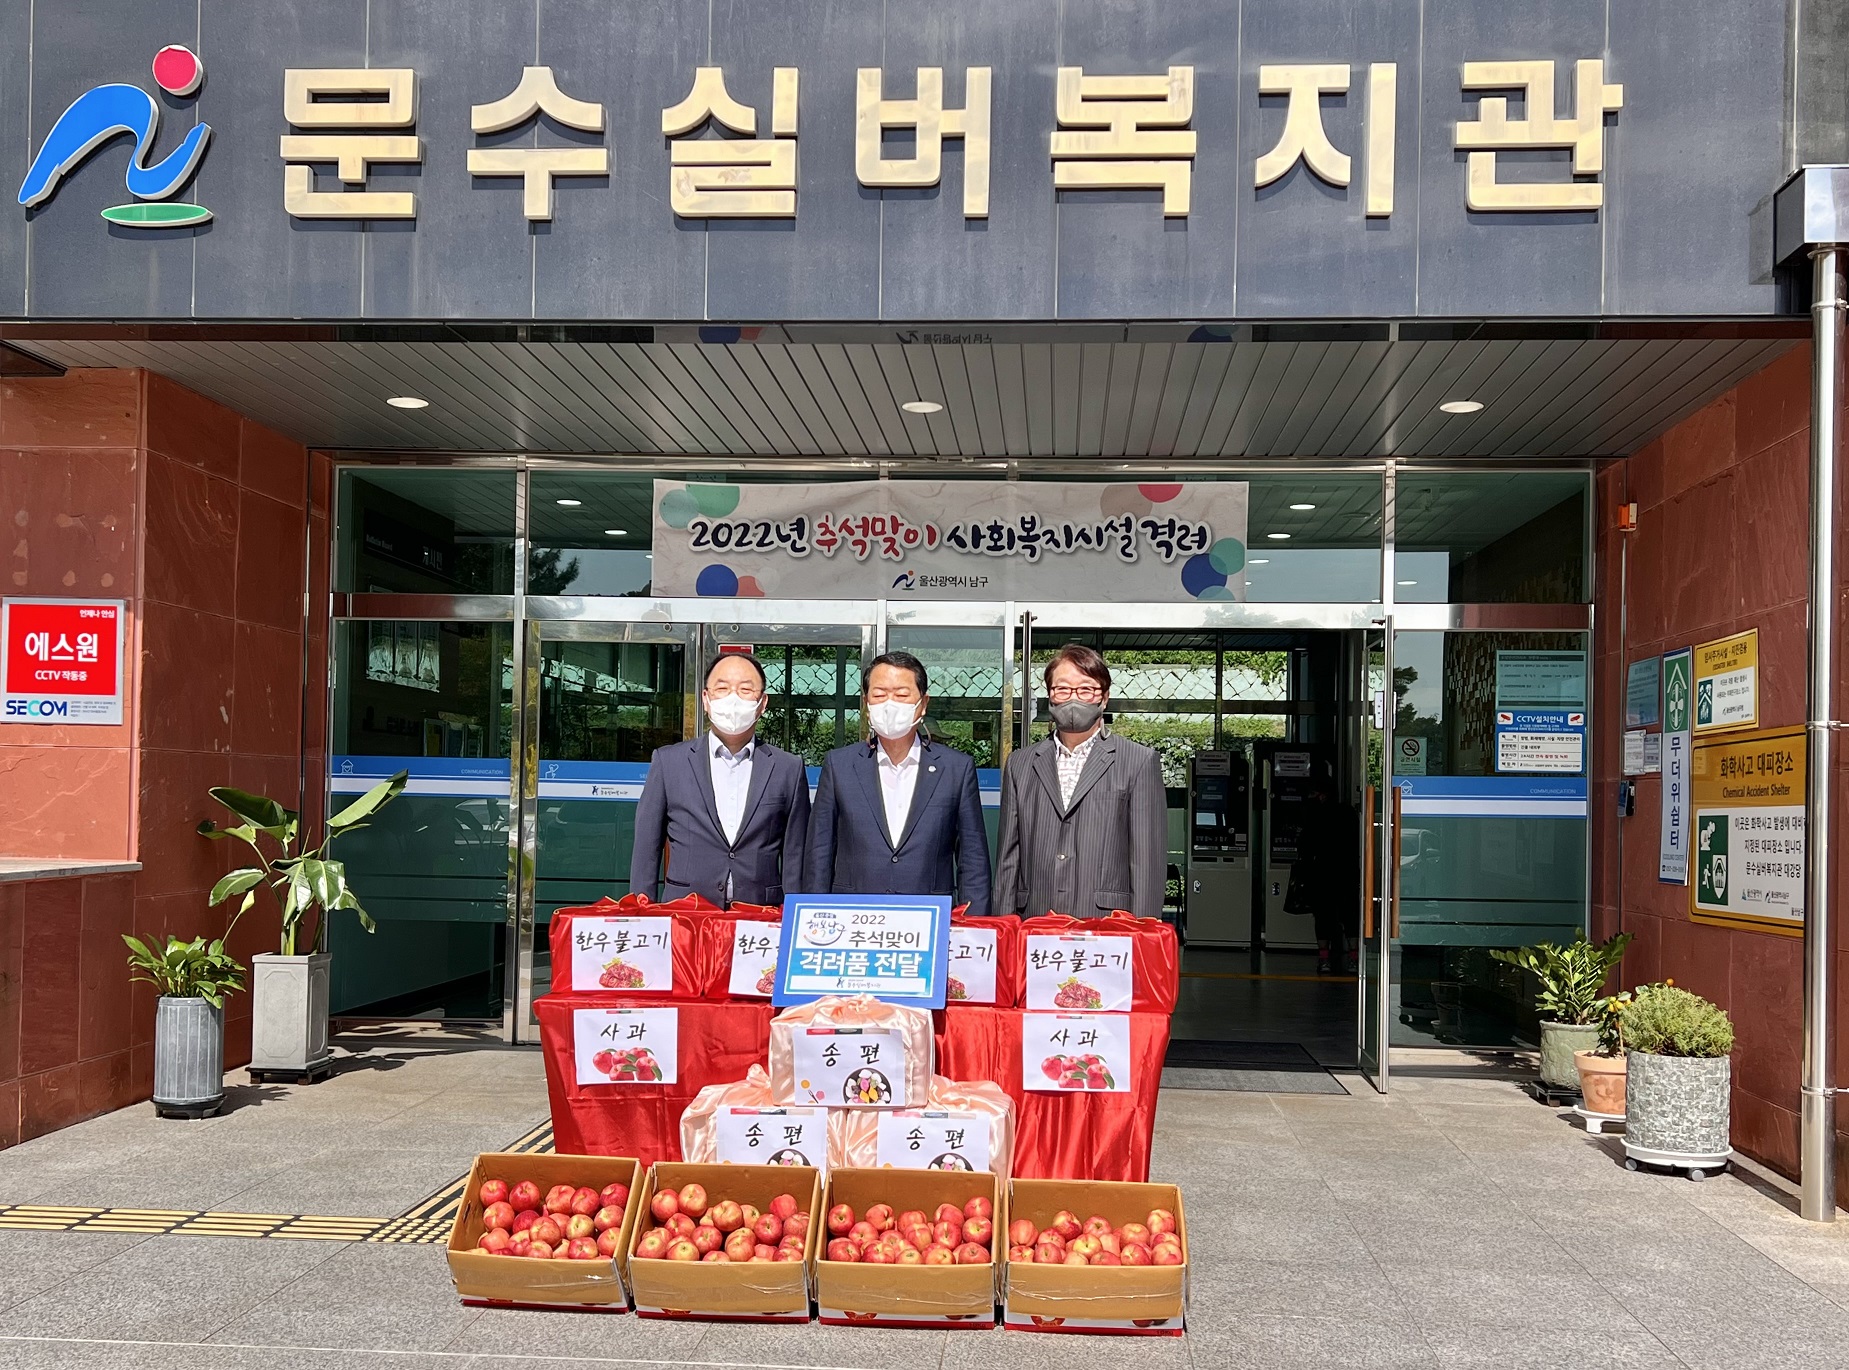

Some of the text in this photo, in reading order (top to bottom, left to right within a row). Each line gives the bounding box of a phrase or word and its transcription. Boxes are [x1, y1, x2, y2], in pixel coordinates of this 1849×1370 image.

[280, 58, 1624, 220] 문수실버복지관
[690, 514, 1208, 559] 2022년 추석맞이 사회복지시설 격려
[918, 575, 989, 588] 울산광역시 남구
[24, 632, 98, 662] 에스원
[35, 670, 87, 681] CCTV 작동중
[6, 699, 68, 717] SECOM
[1516, 715, 1564, 723] CCTV설치안내
[1720, 750, 1794, 779] 화학사고 대피장소
[1670, 736, 1682, 850] 무더위쉼터
[1722, 783, 1791, 798] Chemical Accident Shelter
[1735, 817, 1750, 831] 이곳은
[1751, 816, 1772, 831] 화학사고
[1773, 816, 1790, 831] 발생에
[1744, 839, 1760, 853] 지정된
[1761, 839, 1783, 854] 대피장소
[1746, 861, 1801, 878] 문수실버복지관 대강당
[851, 914, 886, 925] 2022
[737, 933, 780, 958] 한우
[848, 930, 921, 949] 추석맞이
[800, 951, 923, 978] 격려품 전달
